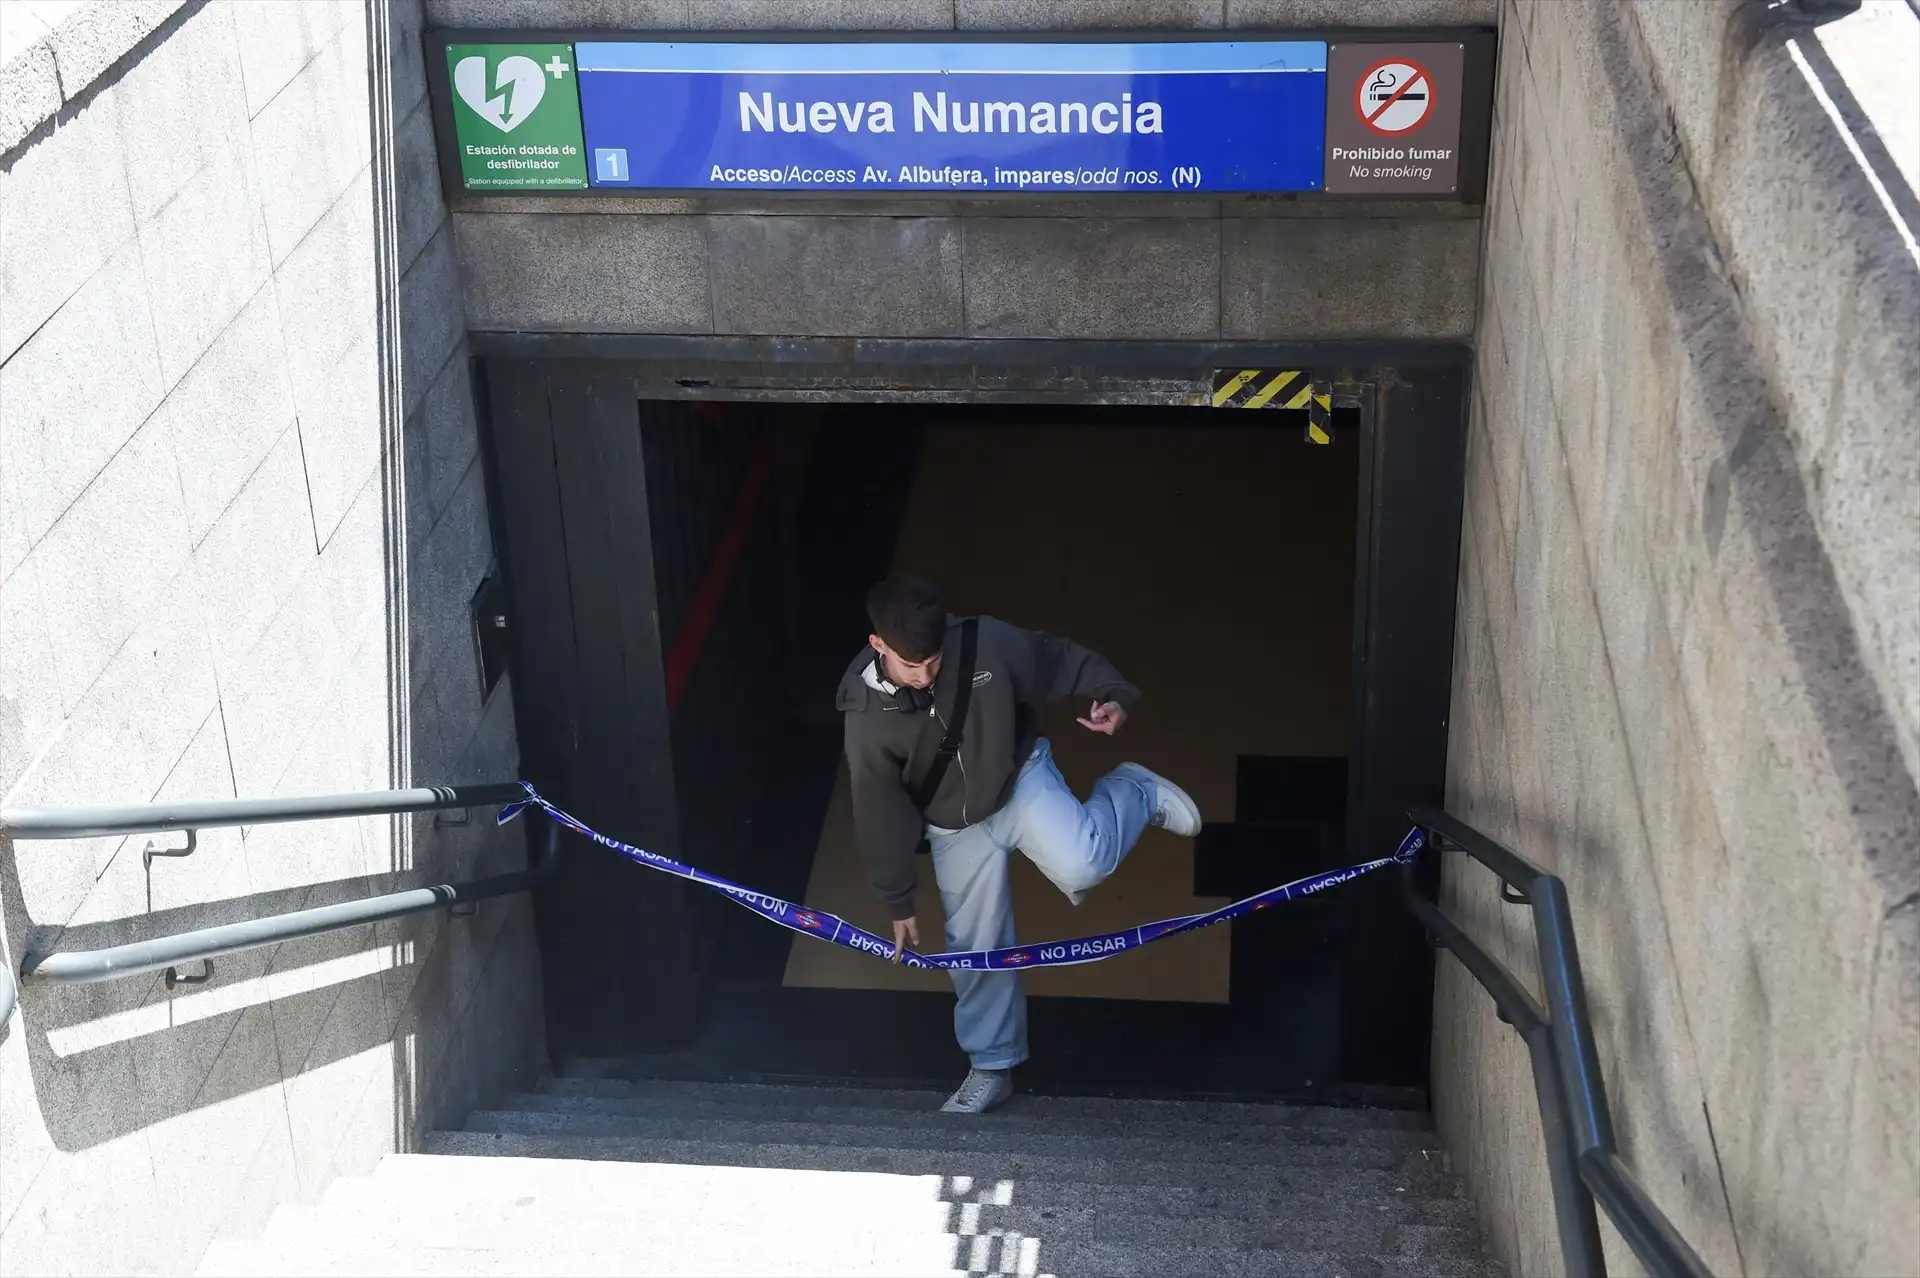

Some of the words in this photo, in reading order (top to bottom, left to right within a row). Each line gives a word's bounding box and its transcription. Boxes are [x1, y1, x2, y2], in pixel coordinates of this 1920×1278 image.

[738, 91, 896, 134] Nueva
[912, 91, 1164, 135] Numancia
[466, 144, 516, 155] Estación
[519, 144, 559, 155] dotada
[561, 144, 577, 155] de
[1332, 147, 1405, 160] Prohibido
[1408, 147, 1452, 160] fumar
[486, 159, 560, 170] desfibrilador
[605, 153, 619, 176] 1
[1349, 165, 1370, 178] No
[1372, 164, 1432, 180] smoking
[468, 177, 491, 185] Station
[492, 177, 524, 186] equipped
[525, 177, 539, 185] with
[710, 164, 856, 184] Acceso/Access
[862, 165, 892, 183] Av.
[898, 165, 988, 187] Albufera,
[994, 166, 1119, 188] impares/odd
[1123, 169, 1163, 185] nos.
[1171, 166, 1201, 188] (N)
[761, 894, 788, 917] NO
[1040, 945, 1066, 962] NO
[1070, 936, 1127, 957] PASAR
